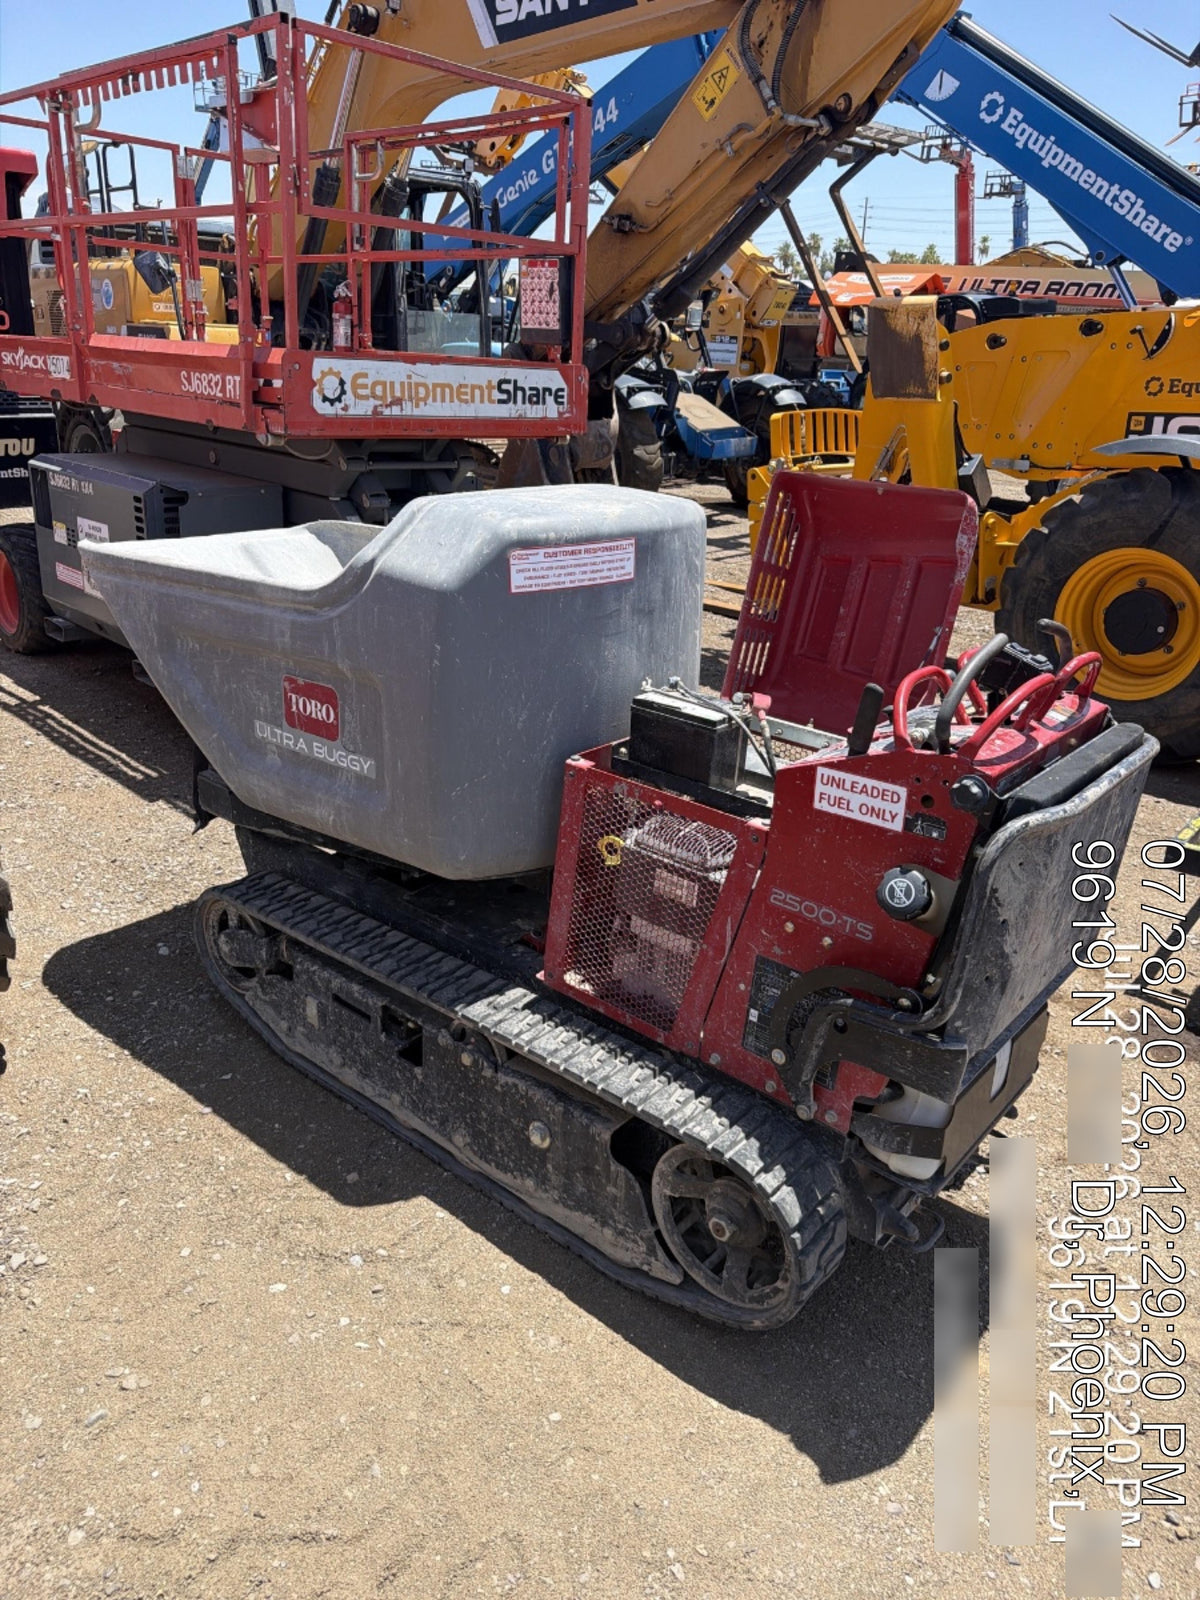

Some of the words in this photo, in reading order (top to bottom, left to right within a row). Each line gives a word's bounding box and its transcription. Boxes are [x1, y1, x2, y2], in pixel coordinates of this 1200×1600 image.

[496, 168, 541, 209] Genie
[1, 346, 46, 370] SKYJACK
[180, 370, 223, 397] SJ6832
[226, 375, 241, 400] RT
[350, 372, 566, 409] EquipmentShare
[287, 692, 335, 724] TORO
[255, 720, 308, 752] ULTRA
[312, 742, 374, 774] BUGGY
[820, 772, 901, 804] UNLEADED
[818, 791, 854, 813] FUEL
[858, 803, 899, 824] ONLY
